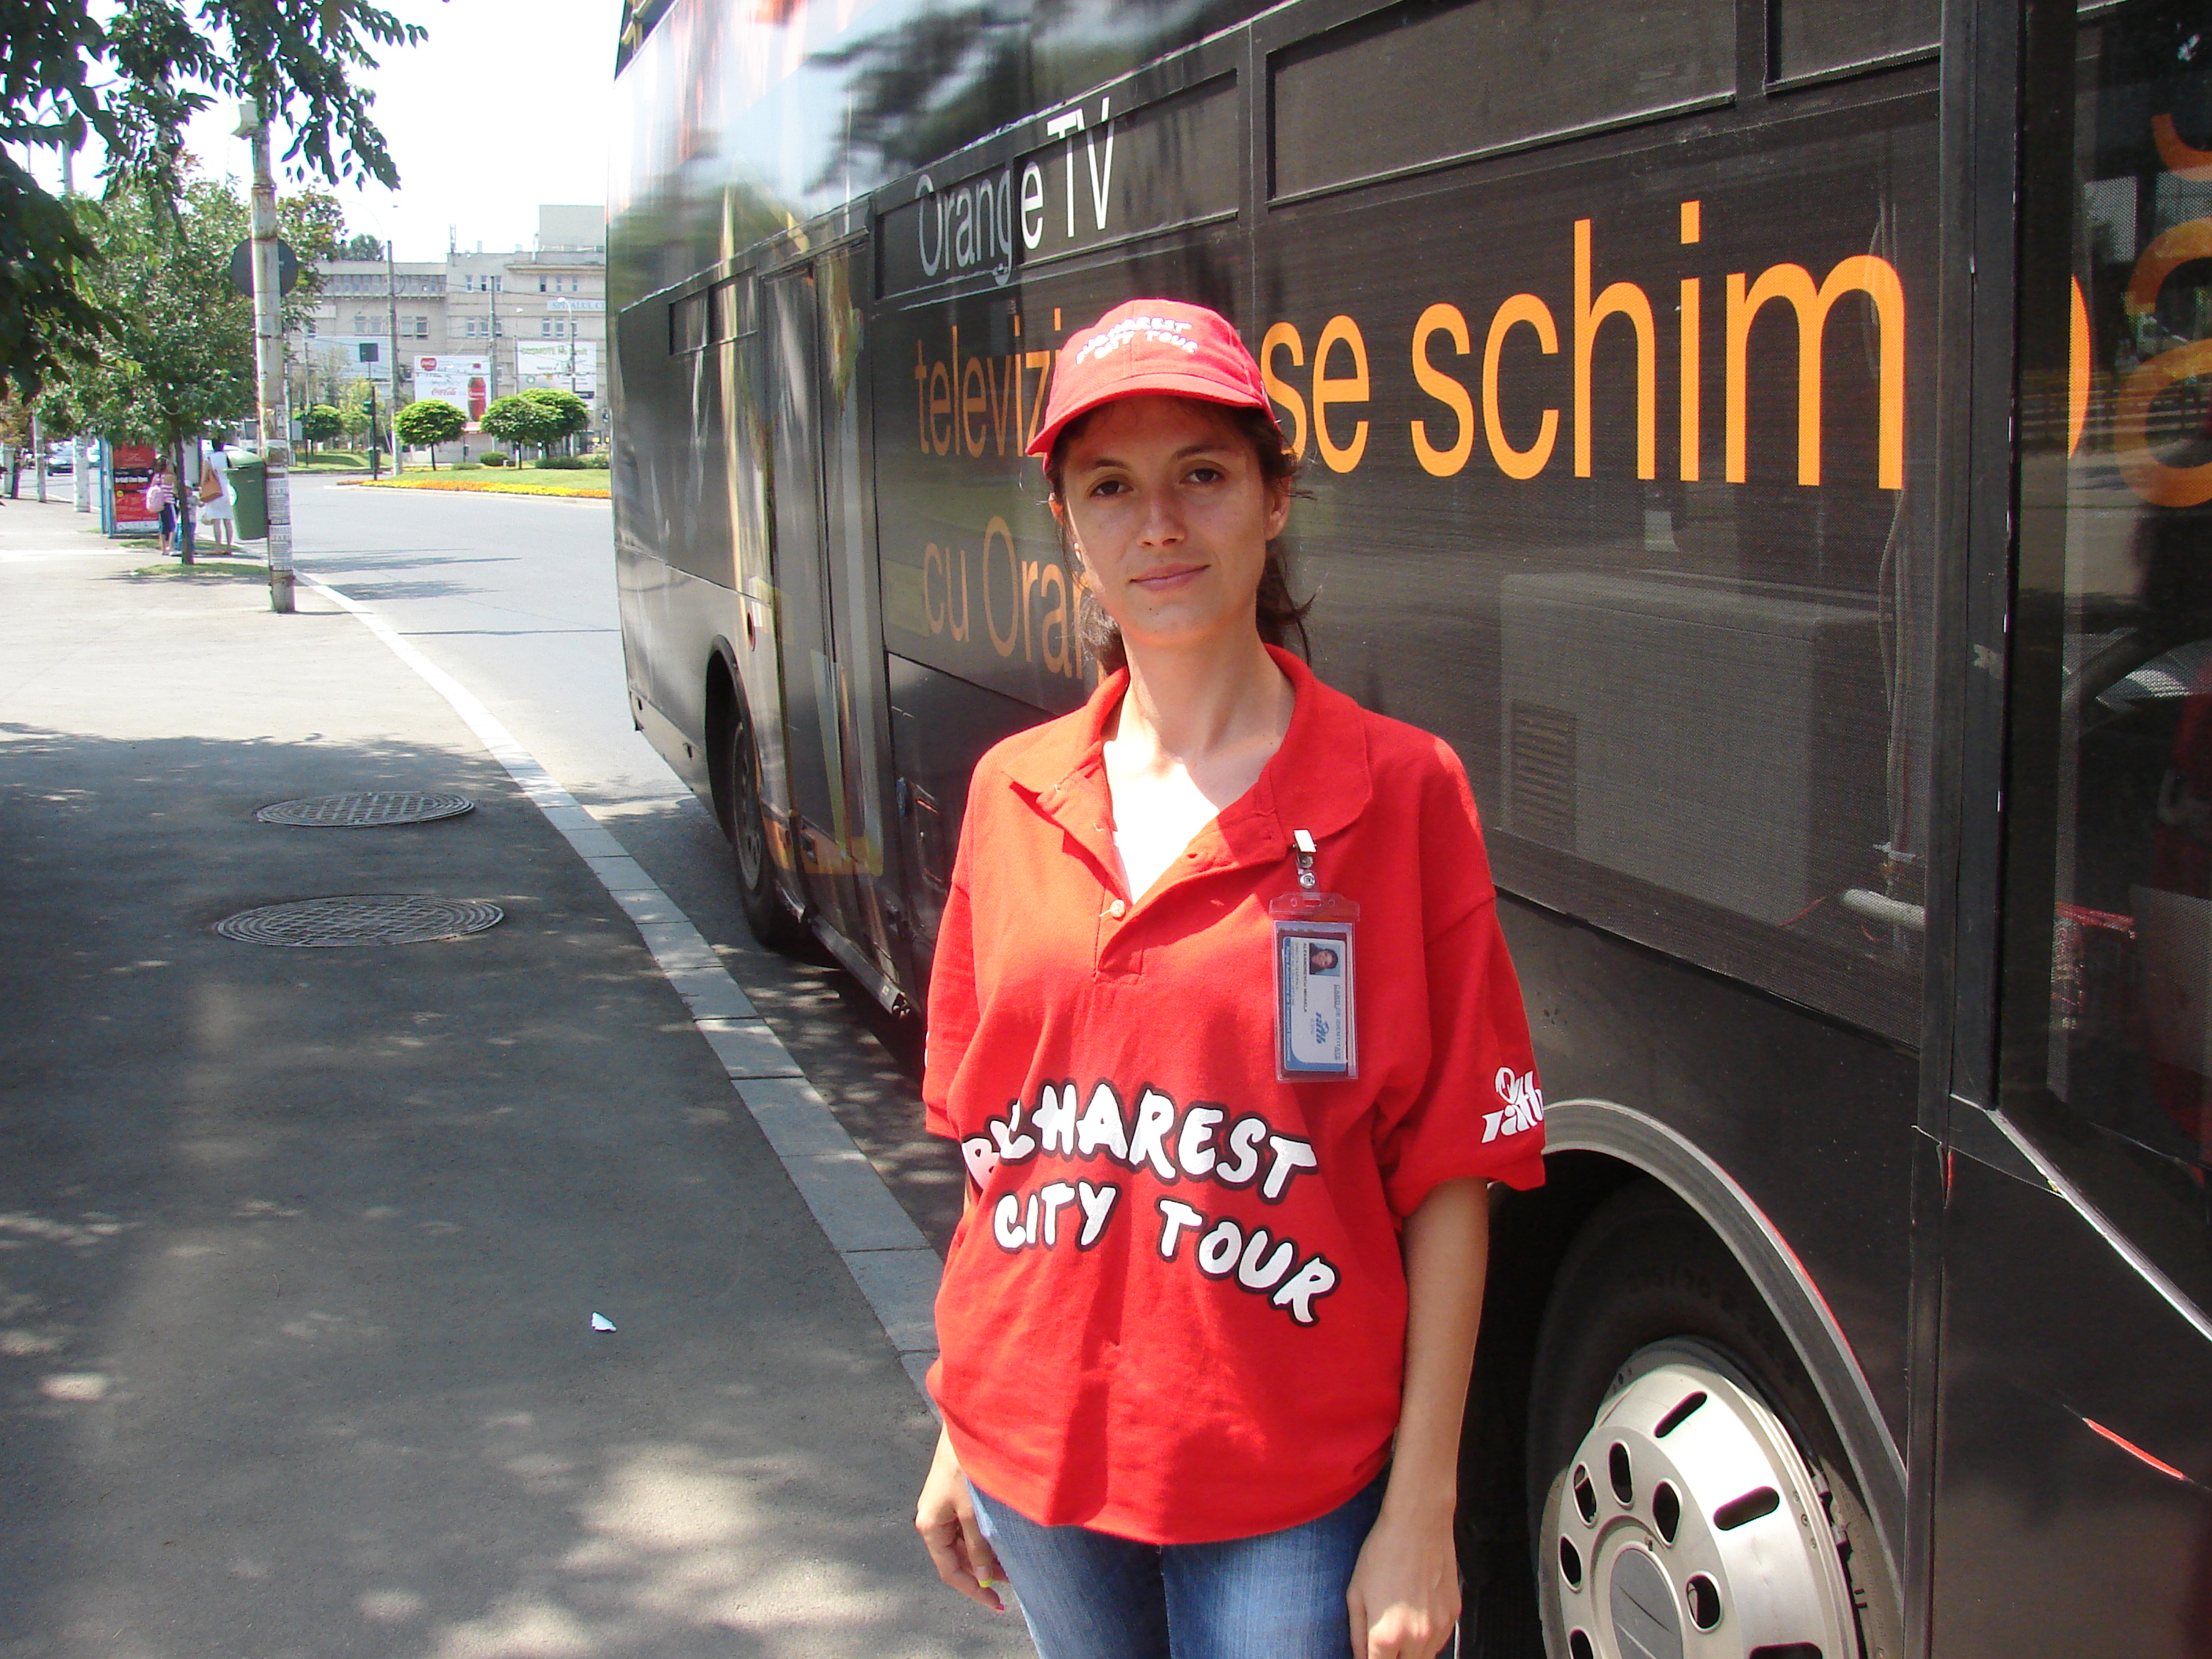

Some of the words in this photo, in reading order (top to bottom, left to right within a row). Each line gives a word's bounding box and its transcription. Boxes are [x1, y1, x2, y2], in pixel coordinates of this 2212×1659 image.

[915, 162, 1044, 286] Orange
[1046, 97, 1115, 238] TV
[552, 301, 593, 309] SPIALUL
[1260, 314, 1370, 474] se
[923, 543, 969, 643] cu
[994, 1181, 1118, 1251] CITY
[1159, 1199, 1336, 1324] TOUR
